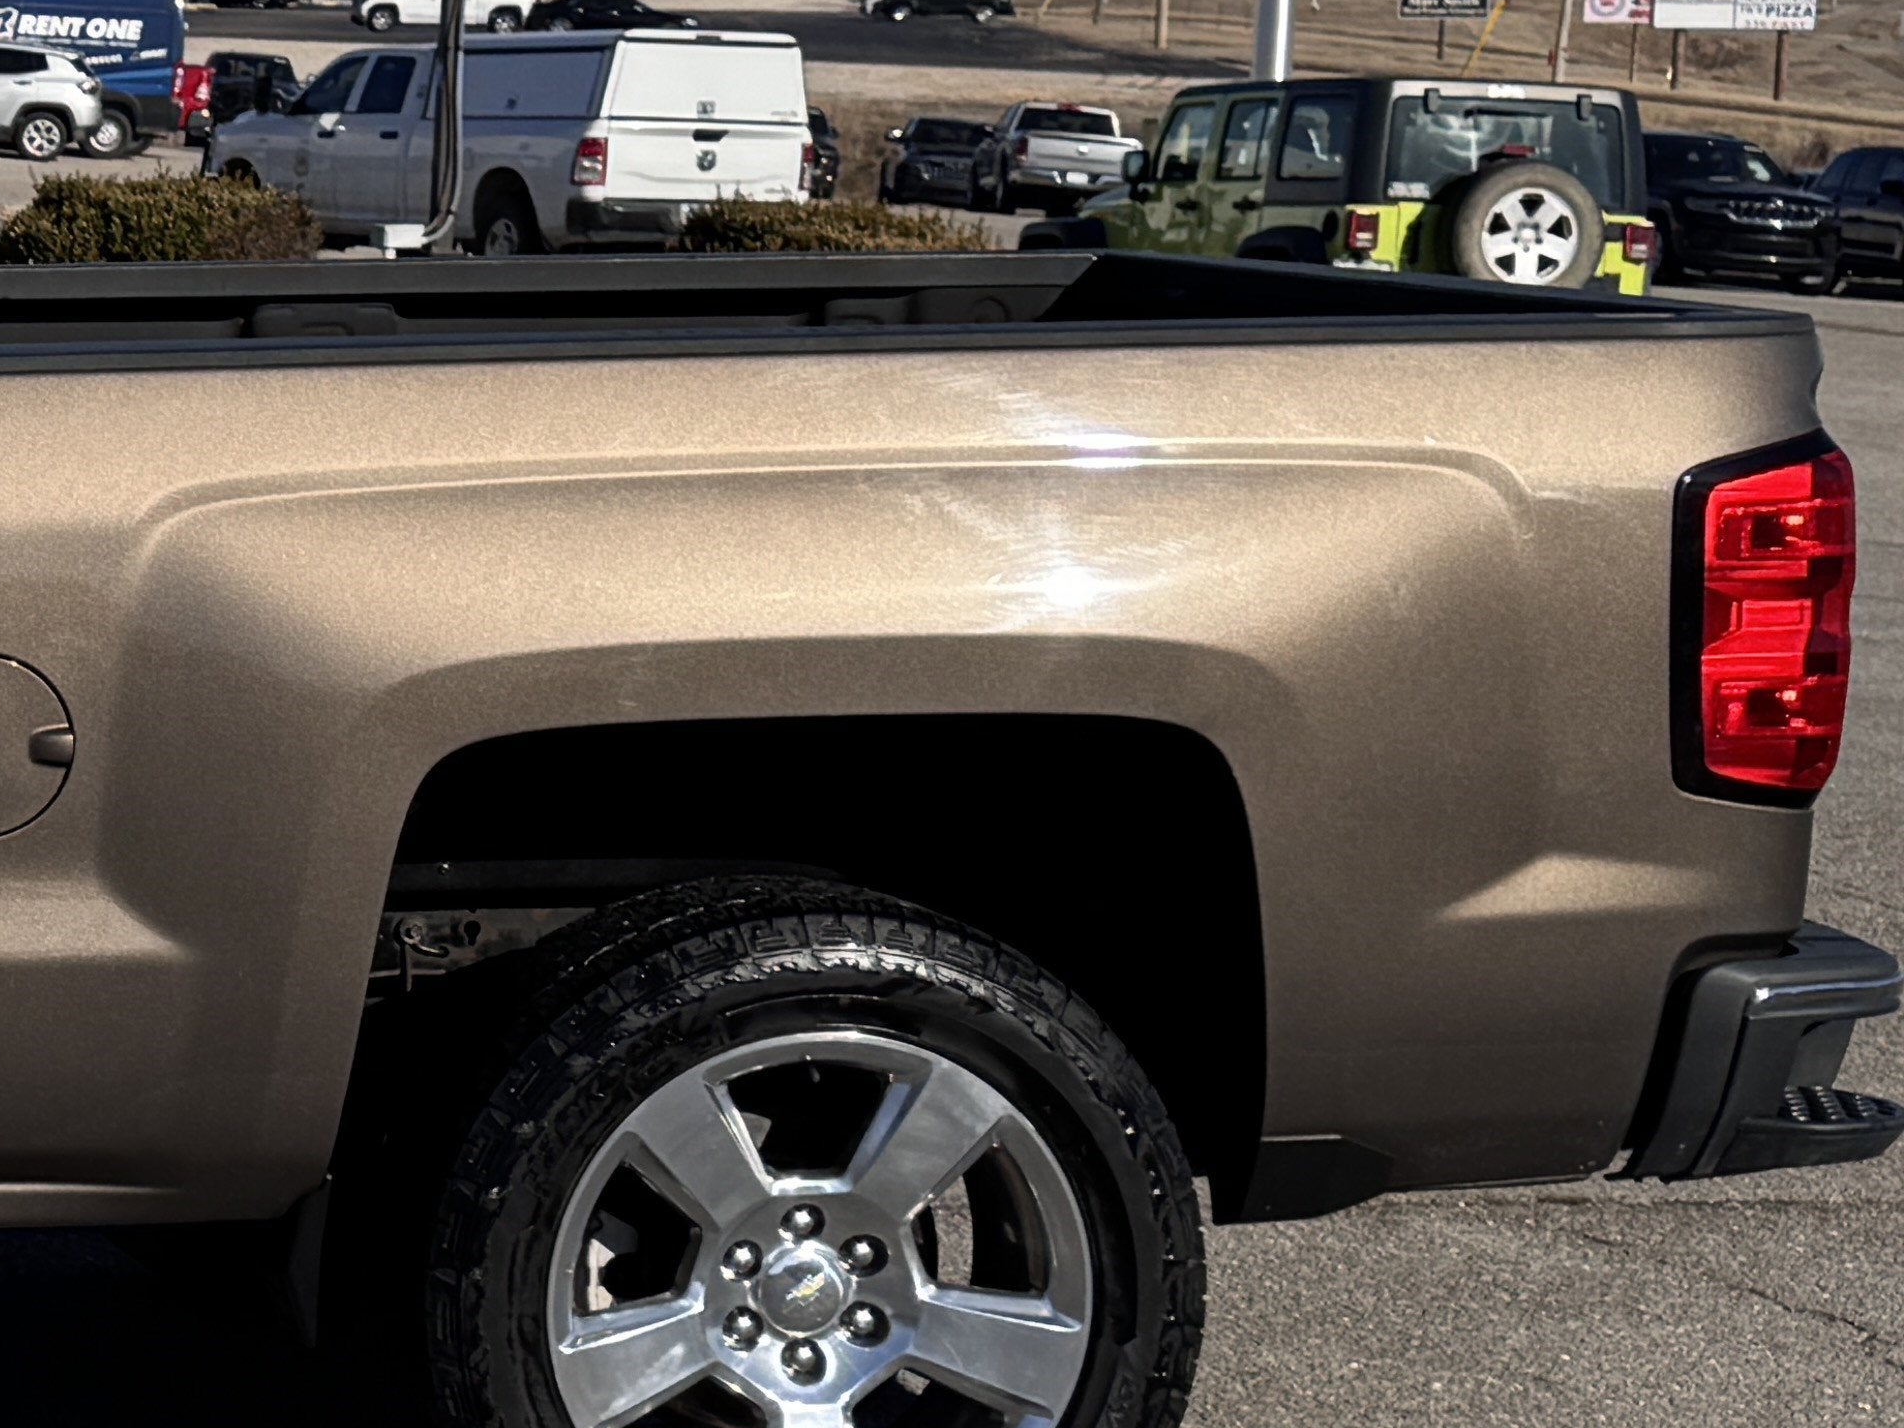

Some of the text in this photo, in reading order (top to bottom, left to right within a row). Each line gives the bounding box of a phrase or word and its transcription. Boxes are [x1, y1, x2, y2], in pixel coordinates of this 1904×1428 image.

[1765, 3, 1813, 17] PIZZA
[17, 14, 144, 41] RENT ONE
